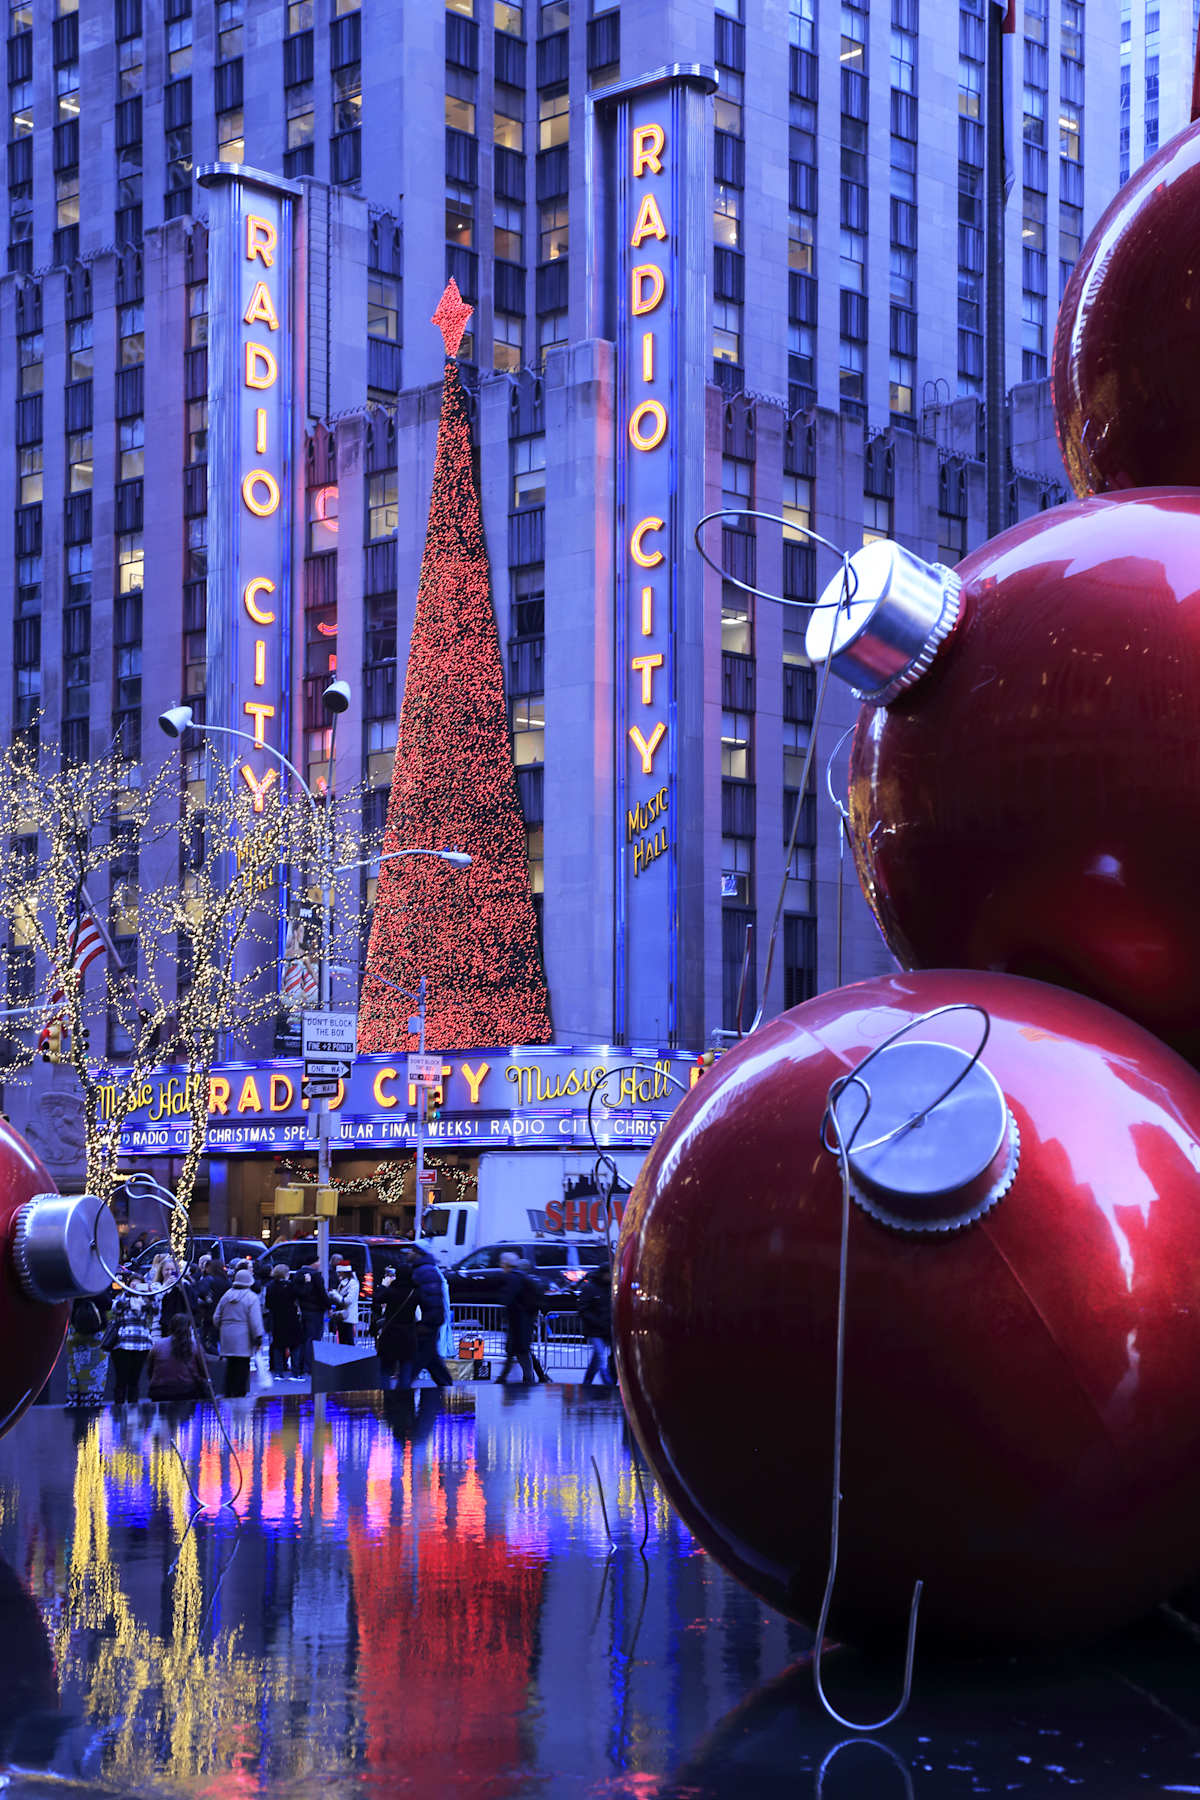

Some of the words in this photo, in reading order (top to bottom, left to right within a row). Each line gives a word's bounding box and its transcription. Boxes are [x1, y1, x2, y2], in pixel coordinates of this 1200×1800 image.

[628, 122, 667, 452] RADIO
[242, 213, 281, 518] RADIO
[628, 516, 667, 774] CITY
[240, 576, 278, 813] CITY
[627, 786, 669, 842] MUSIC
[633, 827, 669, 877] HALL
[316, 1028, 329, 1036] THE
[331, 1028, 345, 1037] BOX
[330, 1019, 353, 1028] BLOCK
[306, 1085, 318, 1094] ONE
[322, 1084, 335, 1093] WAY
[312, 1065, 325, 1073] ONE
[504, 1064, 608, 1105] Music
[601, 1059, 673, 1108] Hall
[95, 1084, 154, 1120] Msic
[133, 1130, 169, 1145] RADIO
[175, 1129, 194, 1145] CIT
[208, 1127, 276, 1143] CHRISTMAS
[283, 1124, 374, 1141] SPEULAR
[382, 1123, 418, 1138] FINAL
[428, 1120, 479, 1137] WEEKS!
[490, 1119, 545, 1135] RADIO
[558, 1119, 601, 1135] CITY
